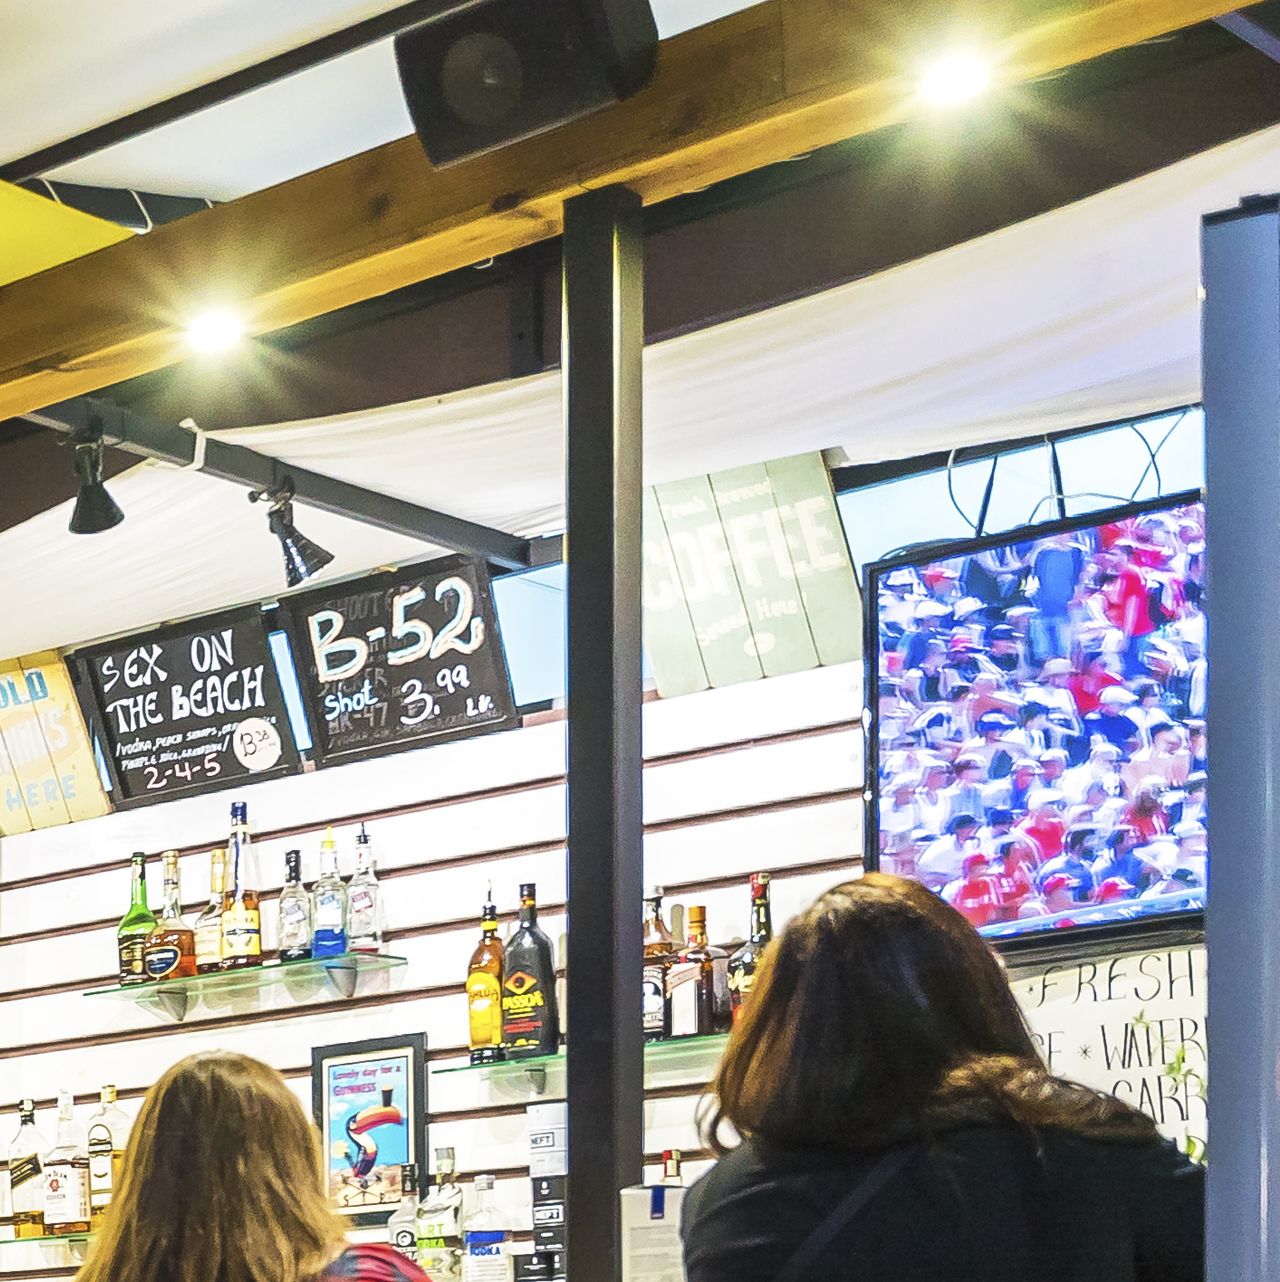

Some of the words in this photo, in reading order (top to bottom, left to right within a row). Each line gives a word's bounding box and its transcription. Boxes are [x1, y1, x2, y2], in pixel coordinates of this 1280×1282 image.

[642, 496, 847, 612] COFFEE
[308, 576, 485, 684] B-52
[102, 643, 168, 693] SEX
[191, 629, 234, 673] ON
[105, 691, 165, 734] THE
[171, 665, 266, 721] BEACH
[325, 679, 379, 721] Shot
[5, 773, 77, 812] HERE
[143, 752, 221, 789] 2-4-5
[1037, 949, 1195, 1007] FRESH
[1100, 1015, 1208, 1071] WATER
[332, 1082, 377, 1097] GUINNESS
